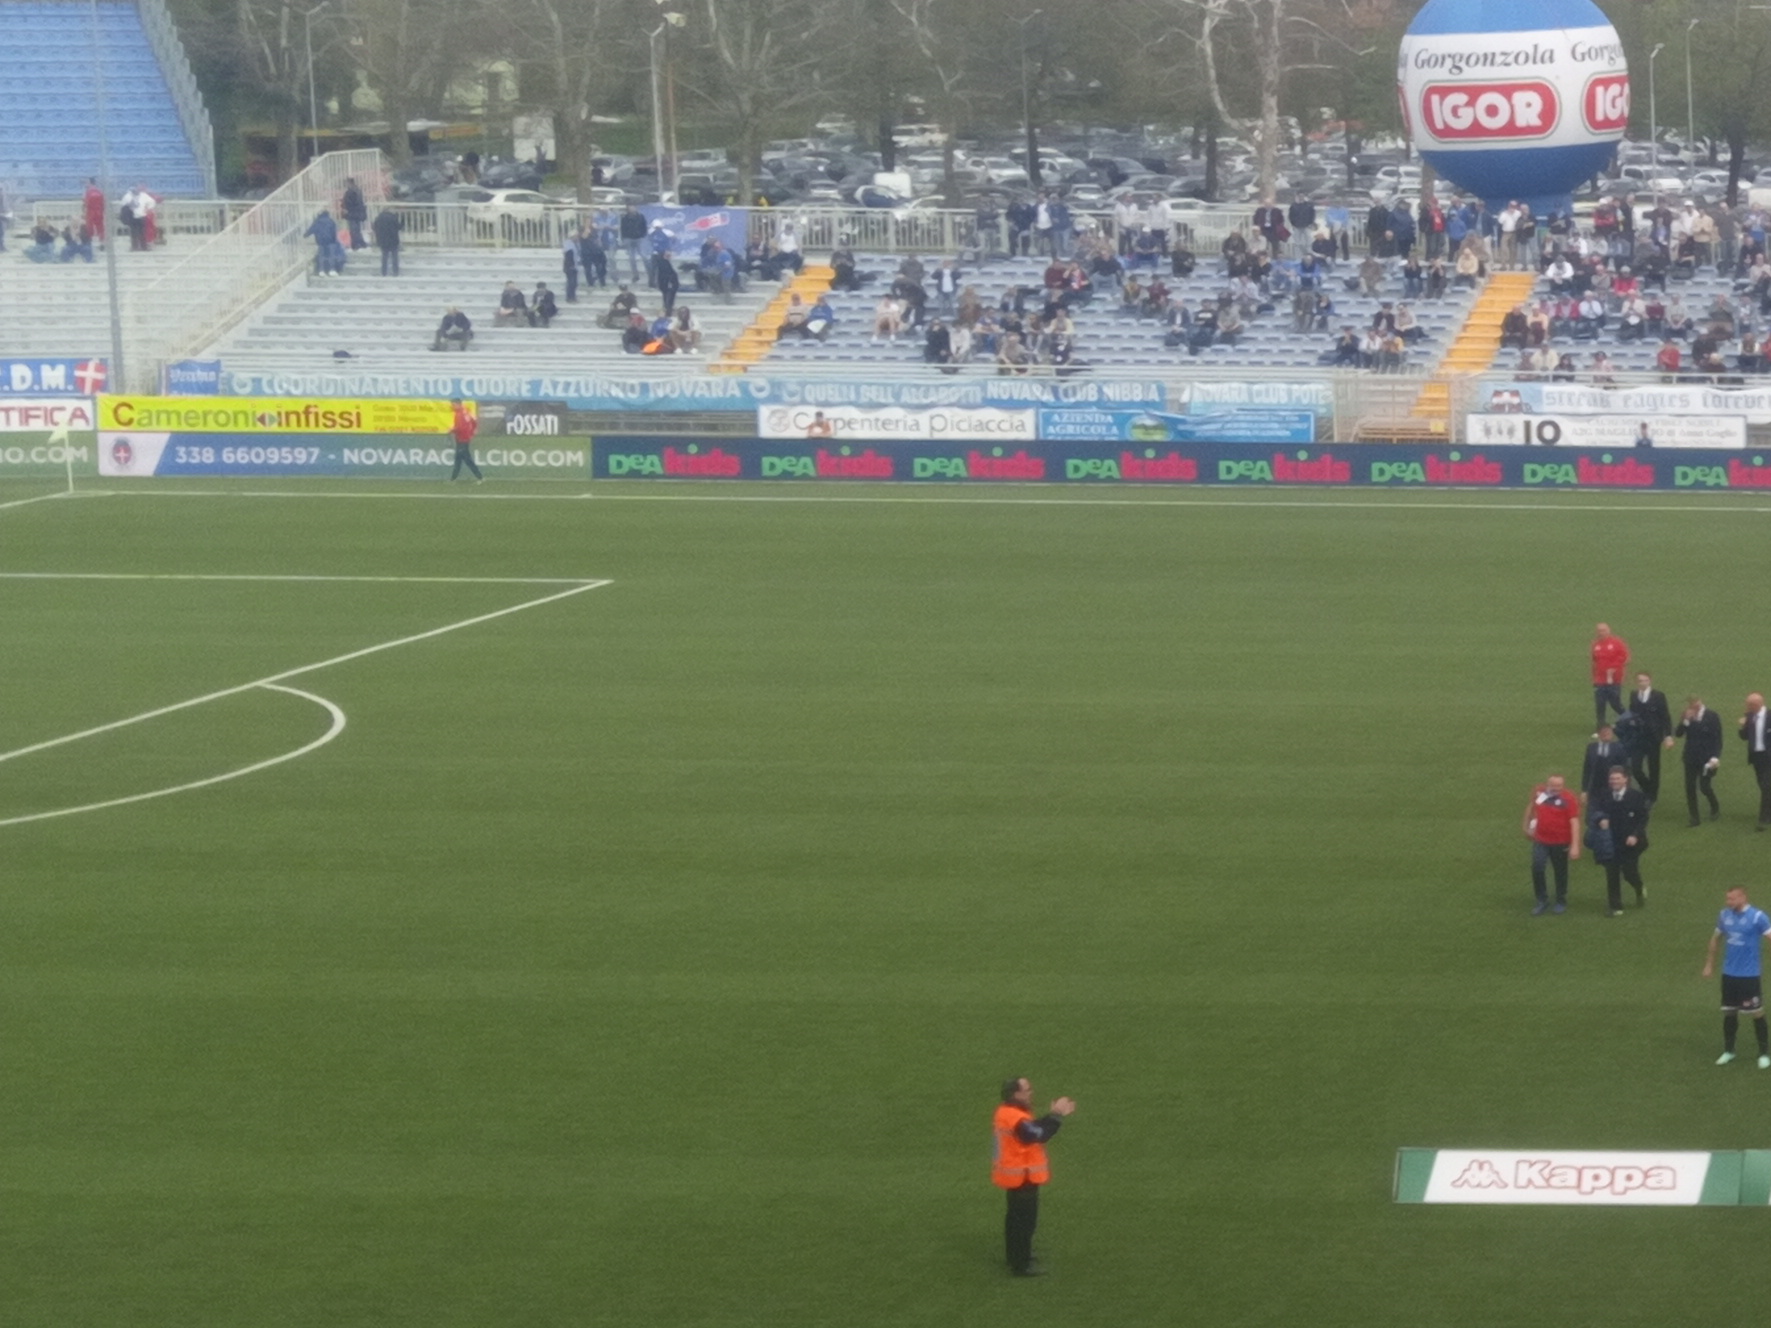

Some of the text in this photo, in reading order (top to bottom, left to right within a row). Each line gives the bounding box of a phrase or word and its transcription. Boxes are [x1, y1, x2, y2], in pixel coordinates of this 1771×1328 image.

[1414, 43, 1556, 76] Gorgonzola
[1571, 41, 1626, 67] Gorgo
[1430, 90, 1544, 131] IGOR
[260, 378, 453, 397] COORDINAMENTO
[461, 378, 531, 397] CUORE
[649, 379, 741, 399] NOVARA
[986, 380, 1054, 401] NOVARA
[1058, 382, 1097, 402] CLUB
[1252, 383, 1288, 404] CLUB
[113, 401, 257, 430] Cameroni
[277, 403, 362, 430] infissi
[793, 412, 920, 436] Cpenteria
[1050, 413, 1114, 424] AZIENDA
[1047, 424, 1120, 436] AGRICOLA
[175, 446, 584, 468] 338 6609597 NOVARACLCIO.COM
[1512, 1158, 1676, 1197] Kappa
